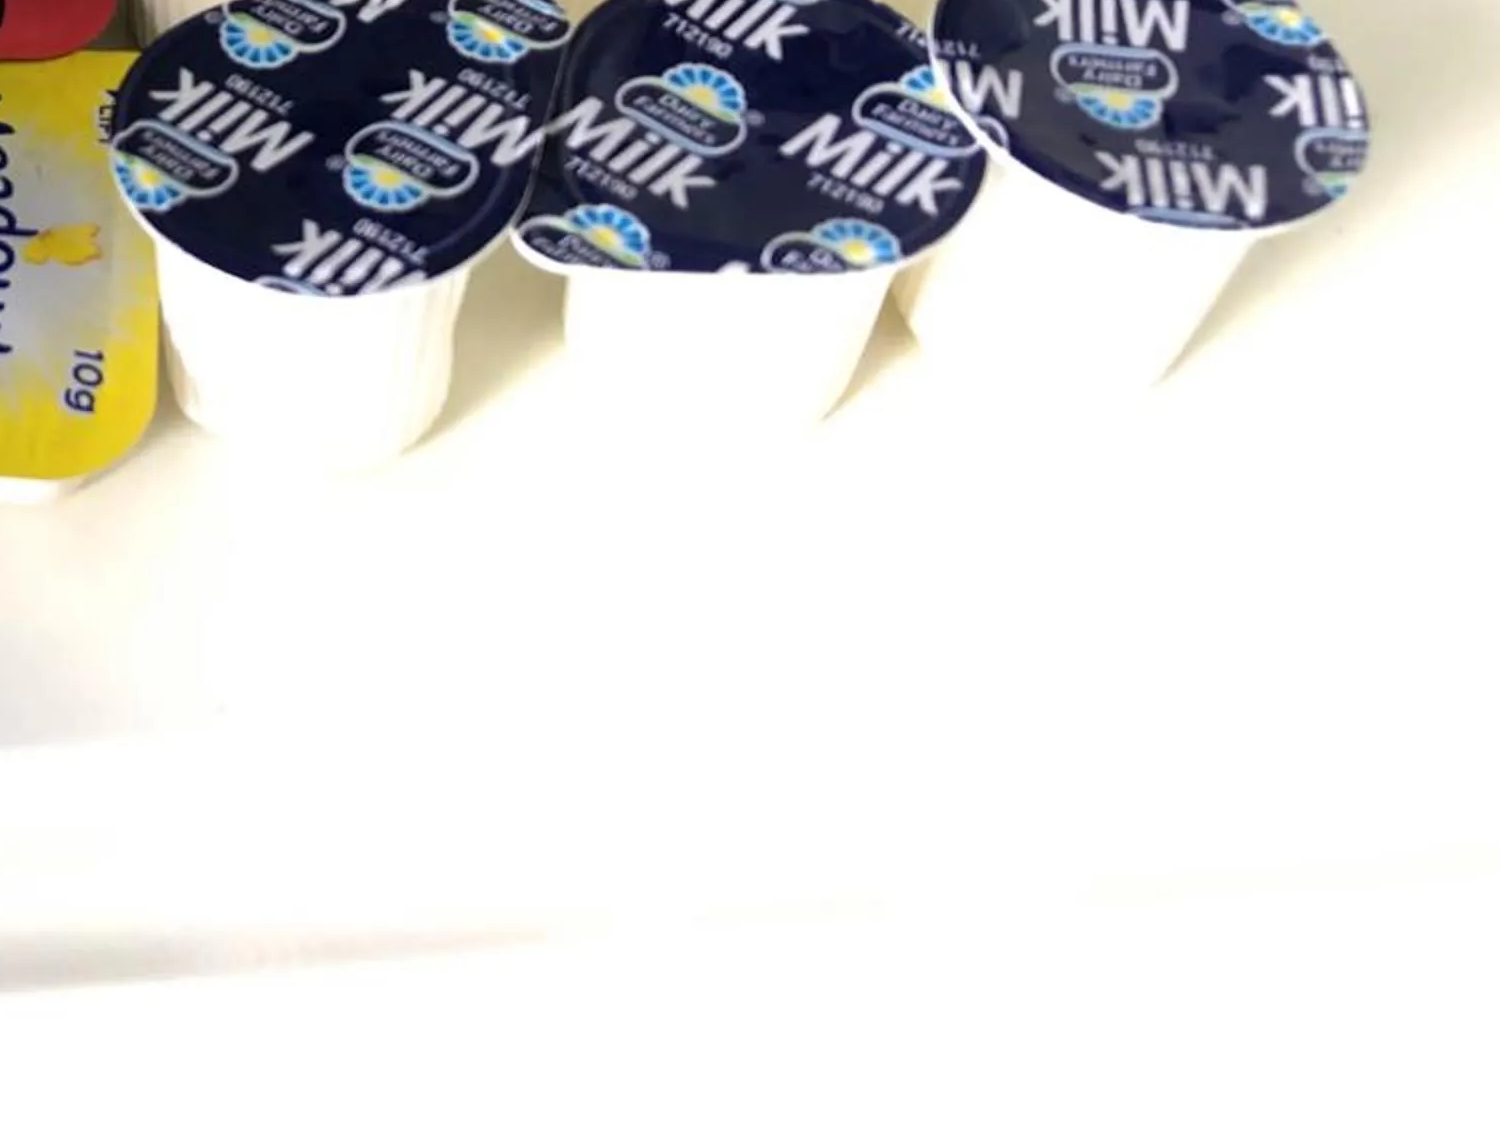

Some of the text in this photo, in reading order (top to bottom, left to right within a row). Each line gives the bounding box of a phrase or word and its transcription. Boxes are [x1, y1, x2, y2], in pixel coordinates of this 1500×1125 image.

[662, 11, 735, 59] 712190
[456, 68, 532, 111] 712190
[1068, 55, 1157, 78] Farmers
[1083, 67, 1143, 88] Dairy
[226, 73, 294, 114] 712190
[380, 69, 546, 167] Milk
[1263, 73, 1357, 128] ilk
[149, 67, 315, 172] Milk
[545, 98, 717, 210] Milk
[564, 154, 639, 201] 712190
[779, 113, 965, 217] Milk
[807, 173, 886, 216] 712190
[1094, 151, 1268, 221] Milk
[63, 347, 105, 415] 10g
